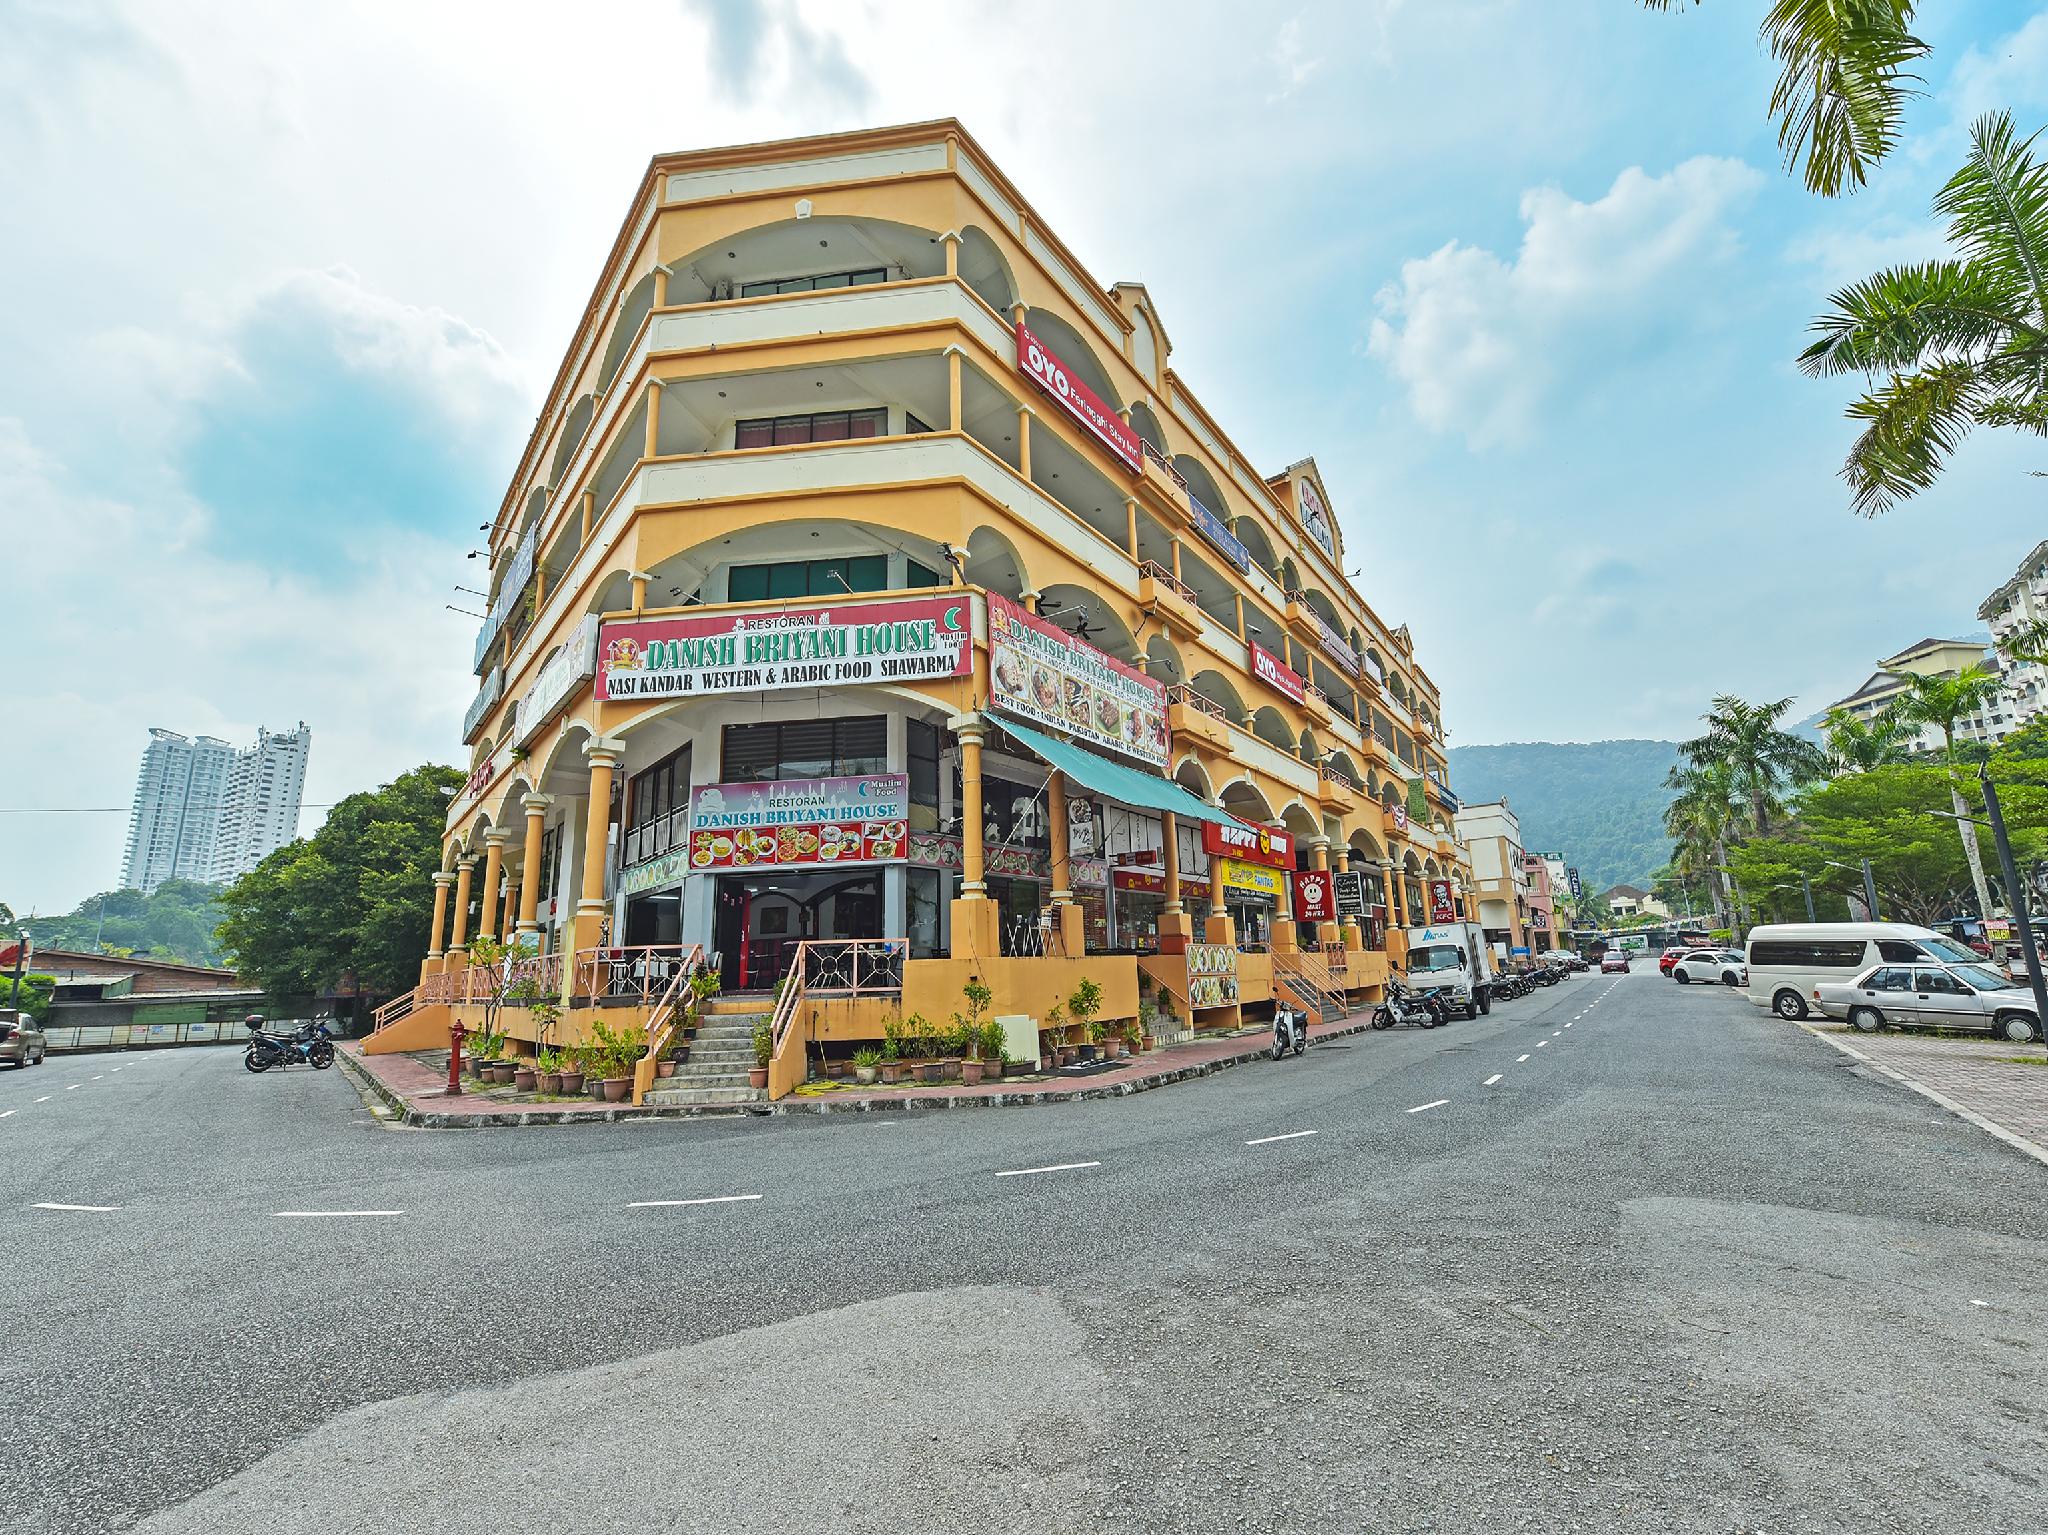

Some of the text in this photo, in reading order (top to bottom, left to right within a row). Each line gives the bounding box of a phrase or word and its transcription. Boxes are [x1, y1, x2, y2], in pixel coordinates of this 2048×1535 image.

[1028, 345, 1139, 459] OYO Feringghi Stay Inn
[748, 615, 815, 631] RESTORAN
[646, 619, 937, 671] DANISH BRIYANI HOUSE
[939, 632, 968, 642] Muslim
[1010, 618, 1156, 706] DANISH BRIYANI HOUSE
[1256, 651, 1277, 680] OYO
[608, 655, 956, 695] NASI KANDAR WESTERN & ARABIC FOOD SHAWARMA
[995, 692, 1015, 706] BEST
[1016, 700, 1036, 716] FOOD
[1040, 712, 1066, 728] INDIAN
[1068, 721, 1100, 741] PAKISTAN
[871, 779, 902, 788] Muslim
[875, 788, 897, 797] Food
[769, 796, 825, 808] RESTORAN
[696, 803, 898, 828] DANISH BRIYANI HOUSE
[1254, 874, 1274, 889] PANTAS
[1299, 874, 1326, 889] HAPPY
[1435, 911, 1453, 920] KFC
